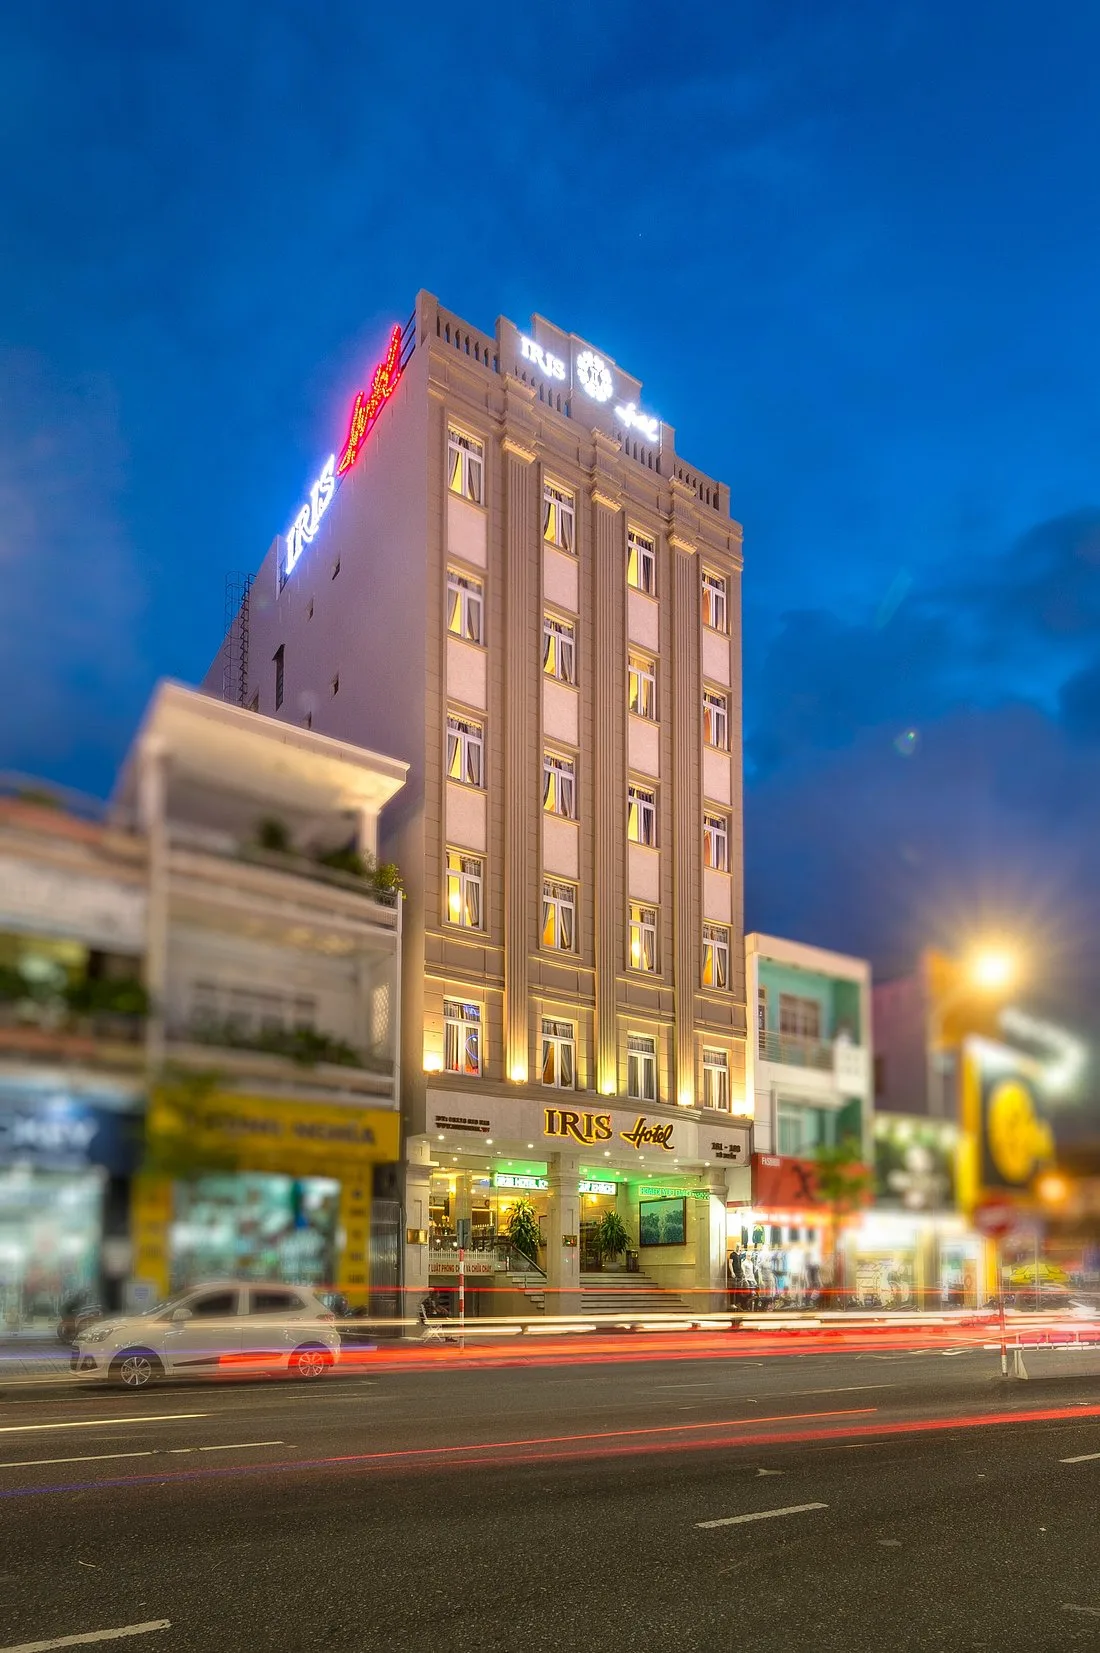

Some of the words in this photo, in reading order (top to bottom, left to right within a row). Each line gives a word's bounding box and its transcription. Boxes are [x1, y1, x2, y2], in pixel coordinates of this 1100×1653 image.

[521, 336, 566, 380] IRIS
[285, 453, 335, 575] IRIS
[544, 1108, 613, 1147] IRIS
[620, 1116, 676, 1152] Hotel
